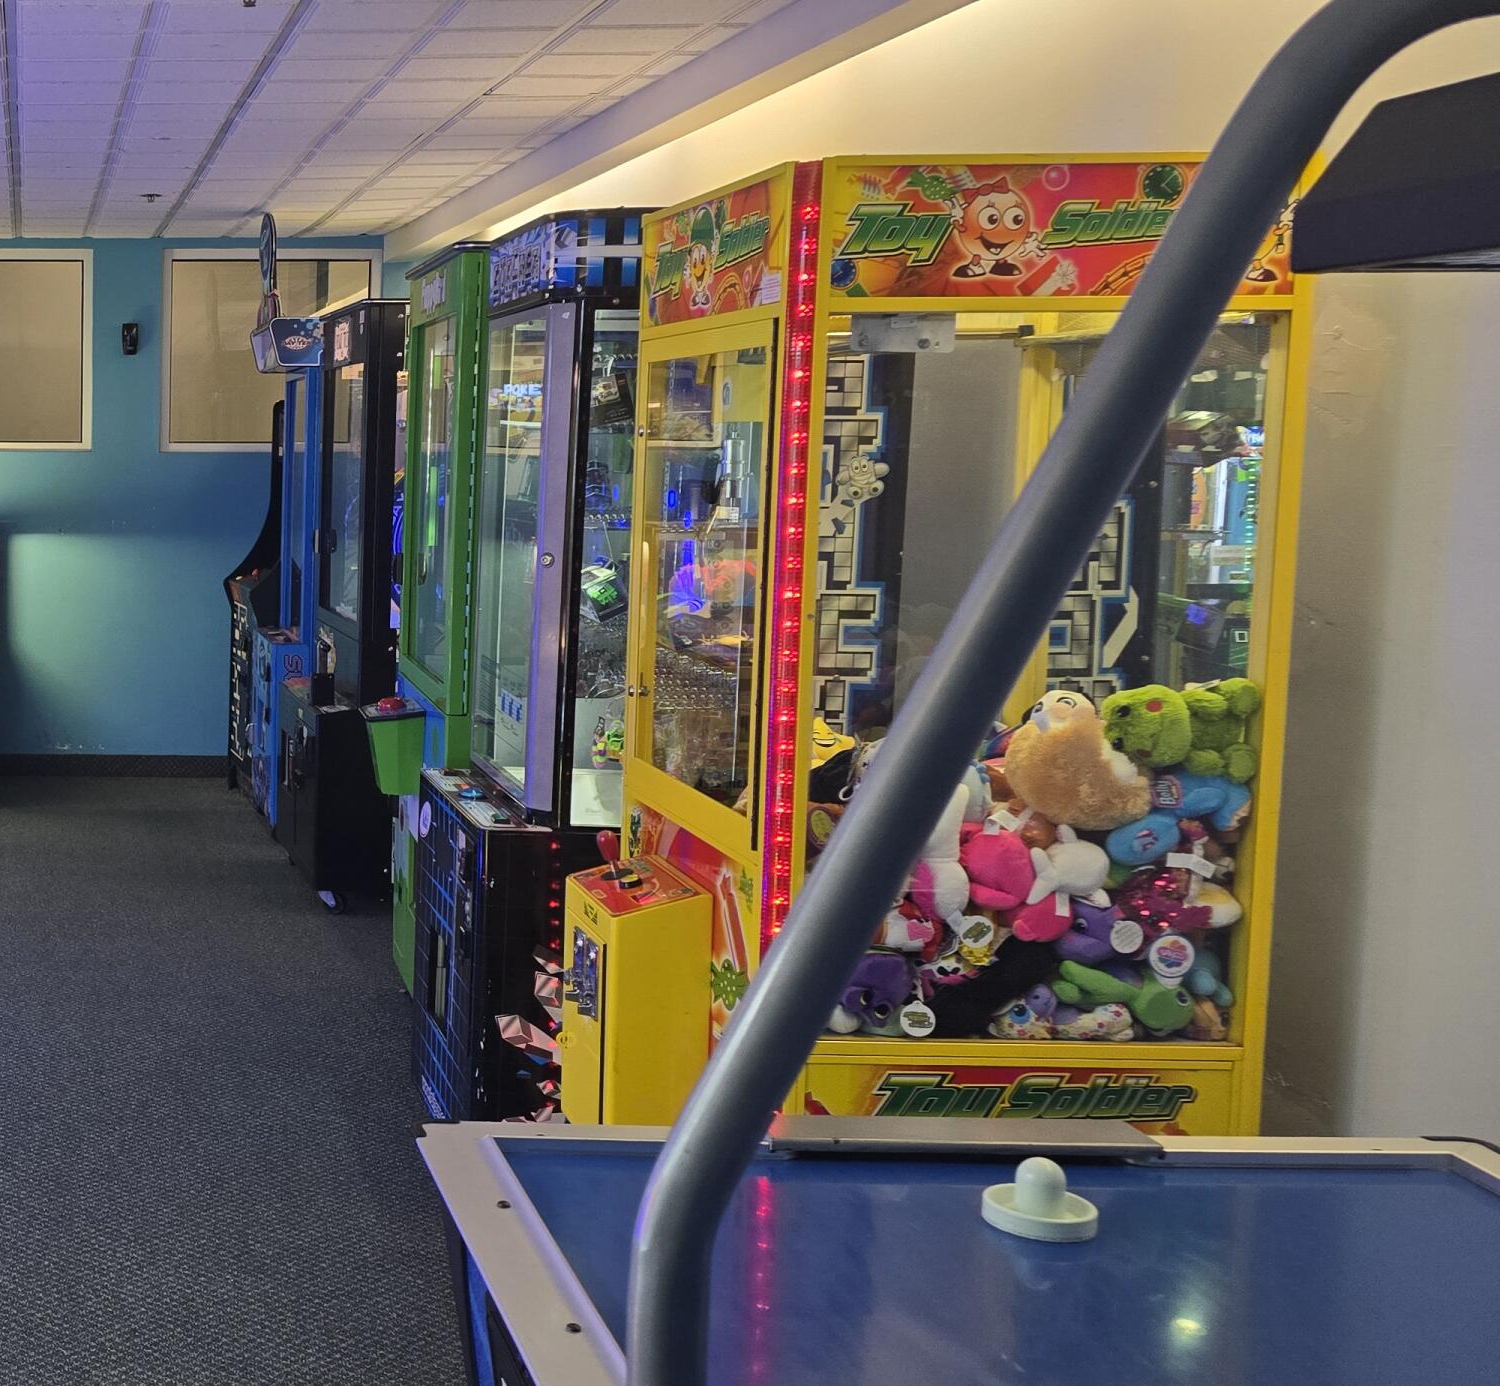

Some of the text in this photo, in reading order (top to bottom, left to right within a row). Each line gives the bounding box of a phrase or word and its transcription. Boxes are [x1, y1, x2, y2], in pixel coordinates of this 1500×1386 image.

[652, 210, 771, 301] Toy Soldier
[833, 199, 1182, 267] Toy Soldie
[999, 1072, 1197, 1121] Soldier
